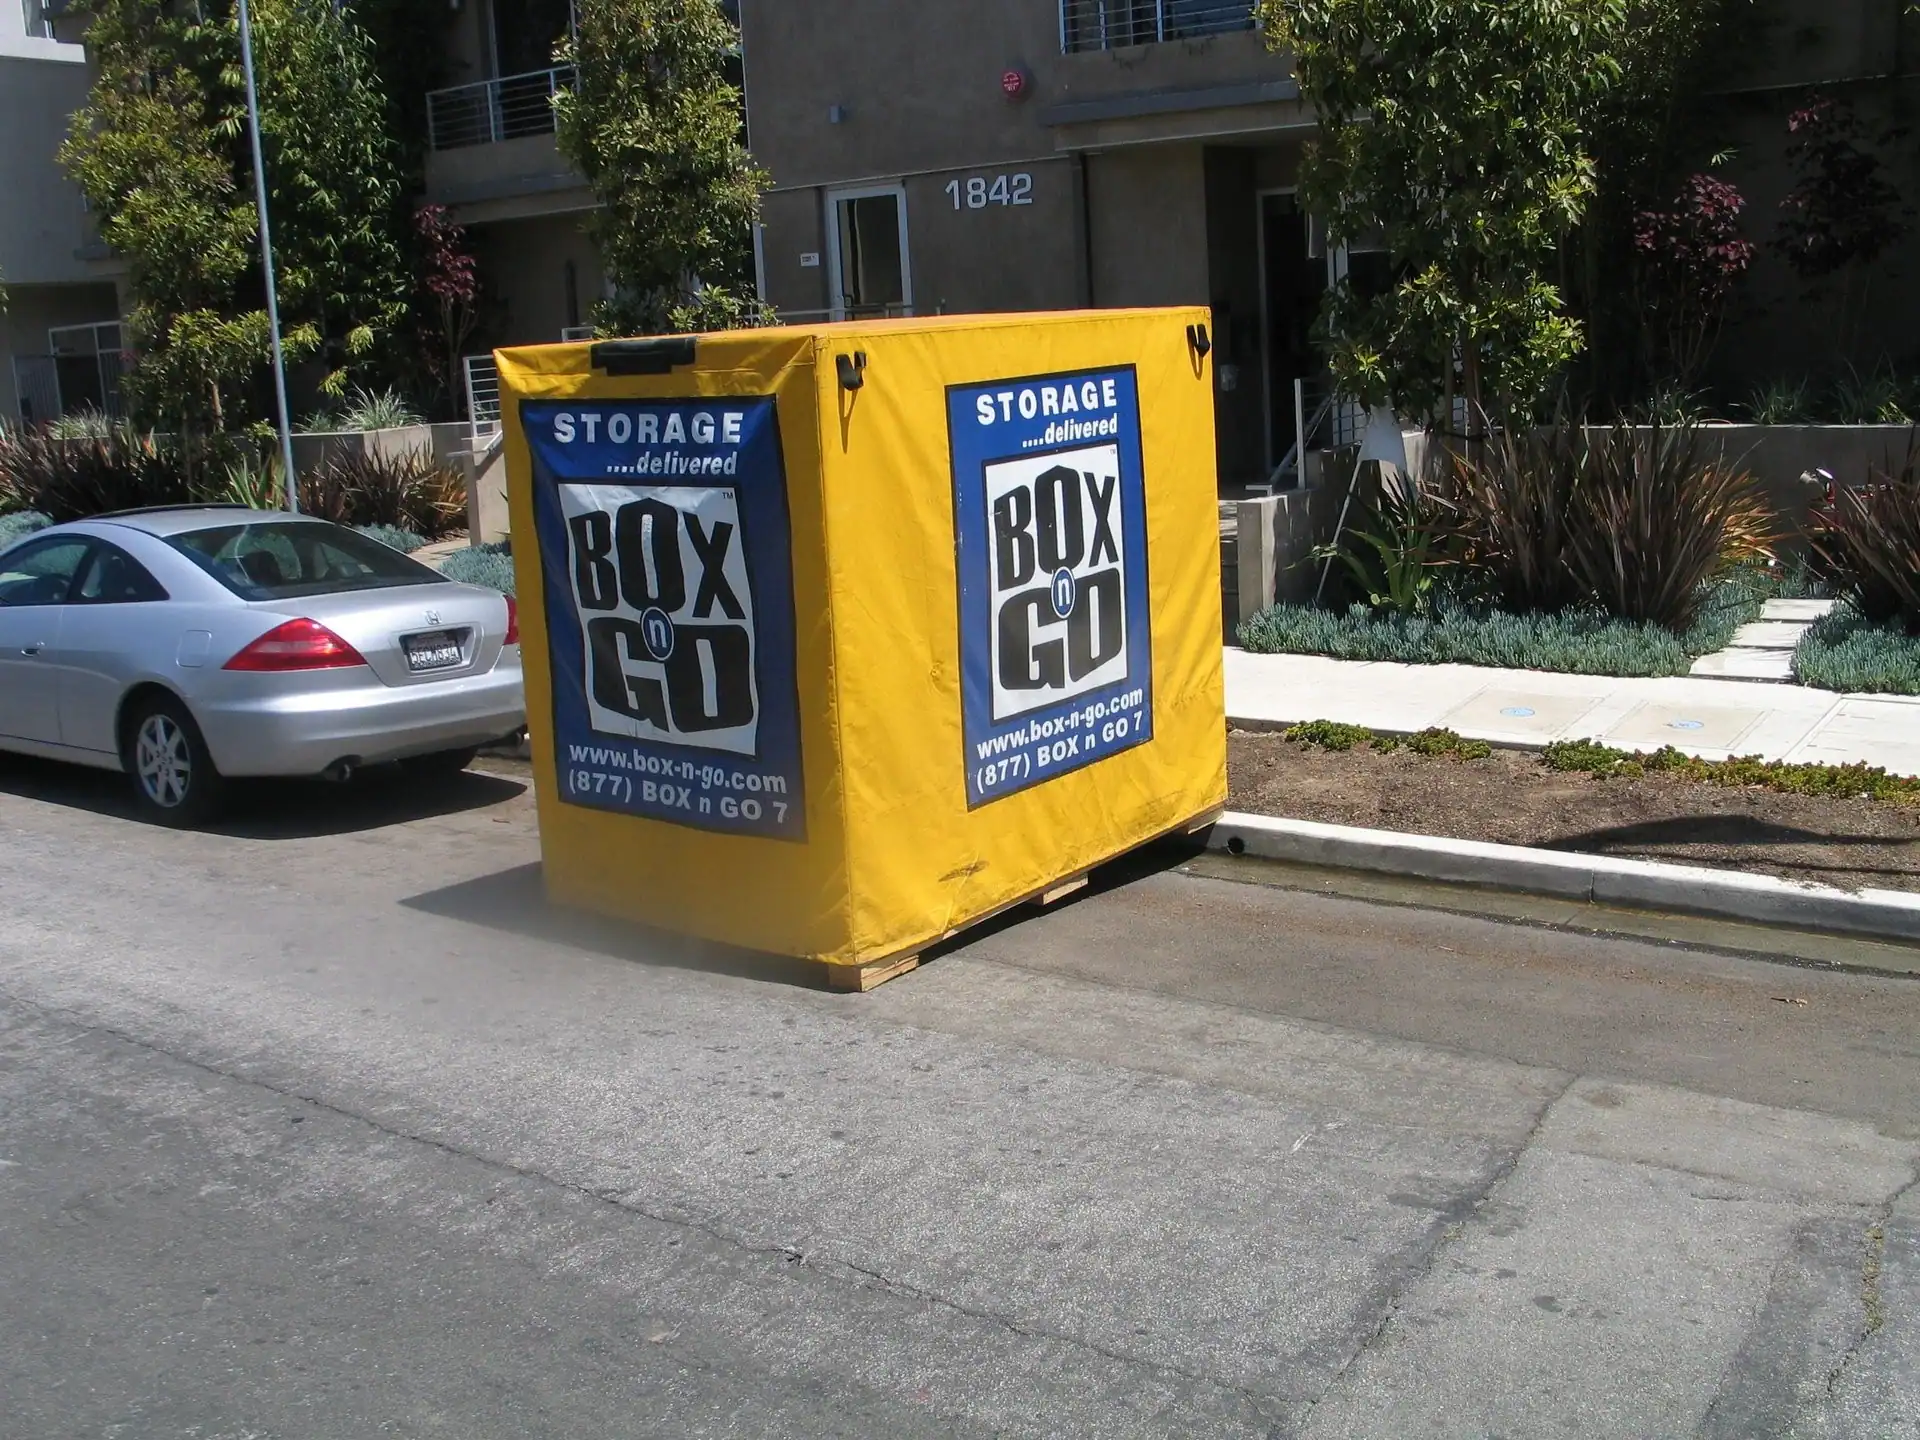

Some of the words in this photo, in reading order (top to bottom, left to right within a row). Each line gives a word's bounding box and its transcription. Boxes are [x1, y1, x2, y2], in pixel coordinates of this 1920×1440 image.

[945, 173, 1033, 211] 1842
[553, 411, 744, 444] STORAGE
[976, 379, 1118, 426] STORAGE
[993, 464, 1120, 592] BOX
[569, 497, 746, 620] BOX
[1057, 576, 1071, 608] n
[648, 618, 668, 649] n
[998, 569, 1123, 690] GO
[587, 616, 754, 734] GO
[976, 688, 1143, 760] www.box-n-go.com
[569, 744, 788, 794] www.box-n-go.com
[976, 753, 1031, 794] (877)
[1037, 734, 1079, 767] BOX
[1085, 734, 1096, 751] n
[1102, 720, 1129, 743] GO
[1134, 711, 1143, 731] 7
[568, 768, 632, 803] (877)
[642, 779, 692, 810] BOX
[699, 795, 711, 814] n
[720, 796, 763, 821] GO
[772, 801, 788, 823] 7
